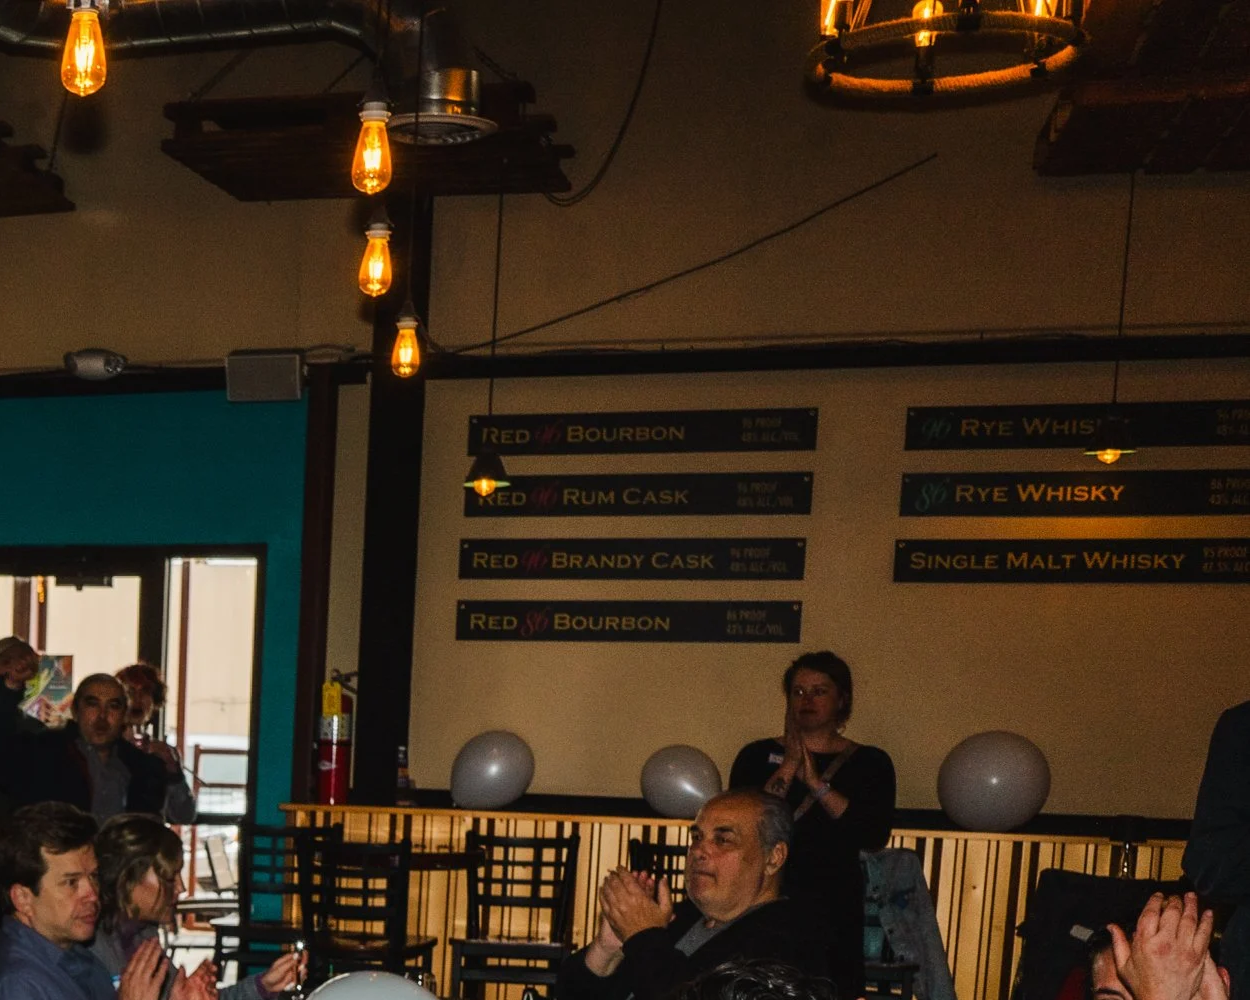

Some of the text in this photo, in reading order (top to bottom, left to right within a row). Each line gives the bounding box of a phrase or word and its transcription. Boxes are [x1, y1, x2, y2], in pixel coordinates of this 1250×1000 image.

[482, 427, 530, 444] RED
[566, 425, 685, 443] BOURBON
[960, 418, 1014, 437] RYE
[1021, 416, 1101, 436] WHIS
[563, 487, 615, 505] RUM
[622, 487, 689, 505] CASK
[955, 484, 1009, 502] RYE
[1016, 484, 1125, 502] WHISKY
[473, 551, 519, 569] RED
[551, 551, 645, 569] BRANDY
[651, 551, 715, 569] CASK
[910, 551, 1187, 570] SINGLE MALT WHISKY
[470, 613, 518, 630] RED
[553, 613, 670, 631] BOURBON
